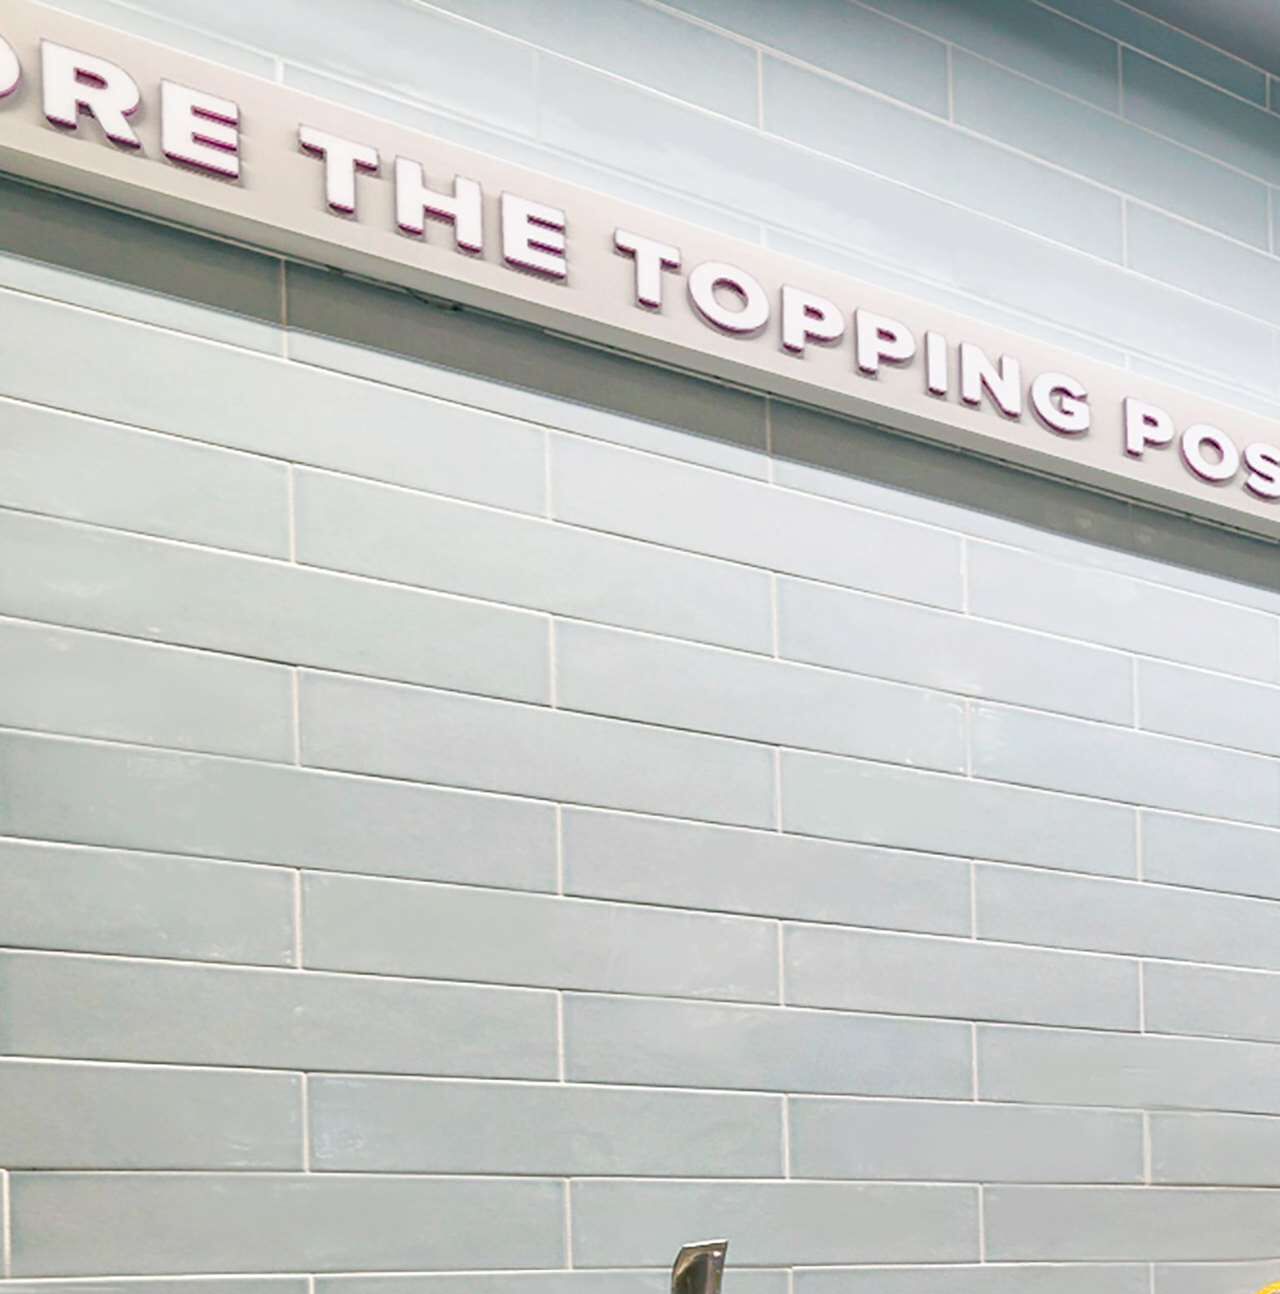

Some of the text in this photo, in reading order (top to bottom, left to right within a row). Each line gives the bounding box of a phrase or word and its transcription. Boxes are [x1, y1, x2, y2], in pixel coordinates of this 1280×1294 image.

[0, 32, 241, 184] RE
[299, 123, 568, 280] THE
[613, 228, 1092, 435] TOPPING
